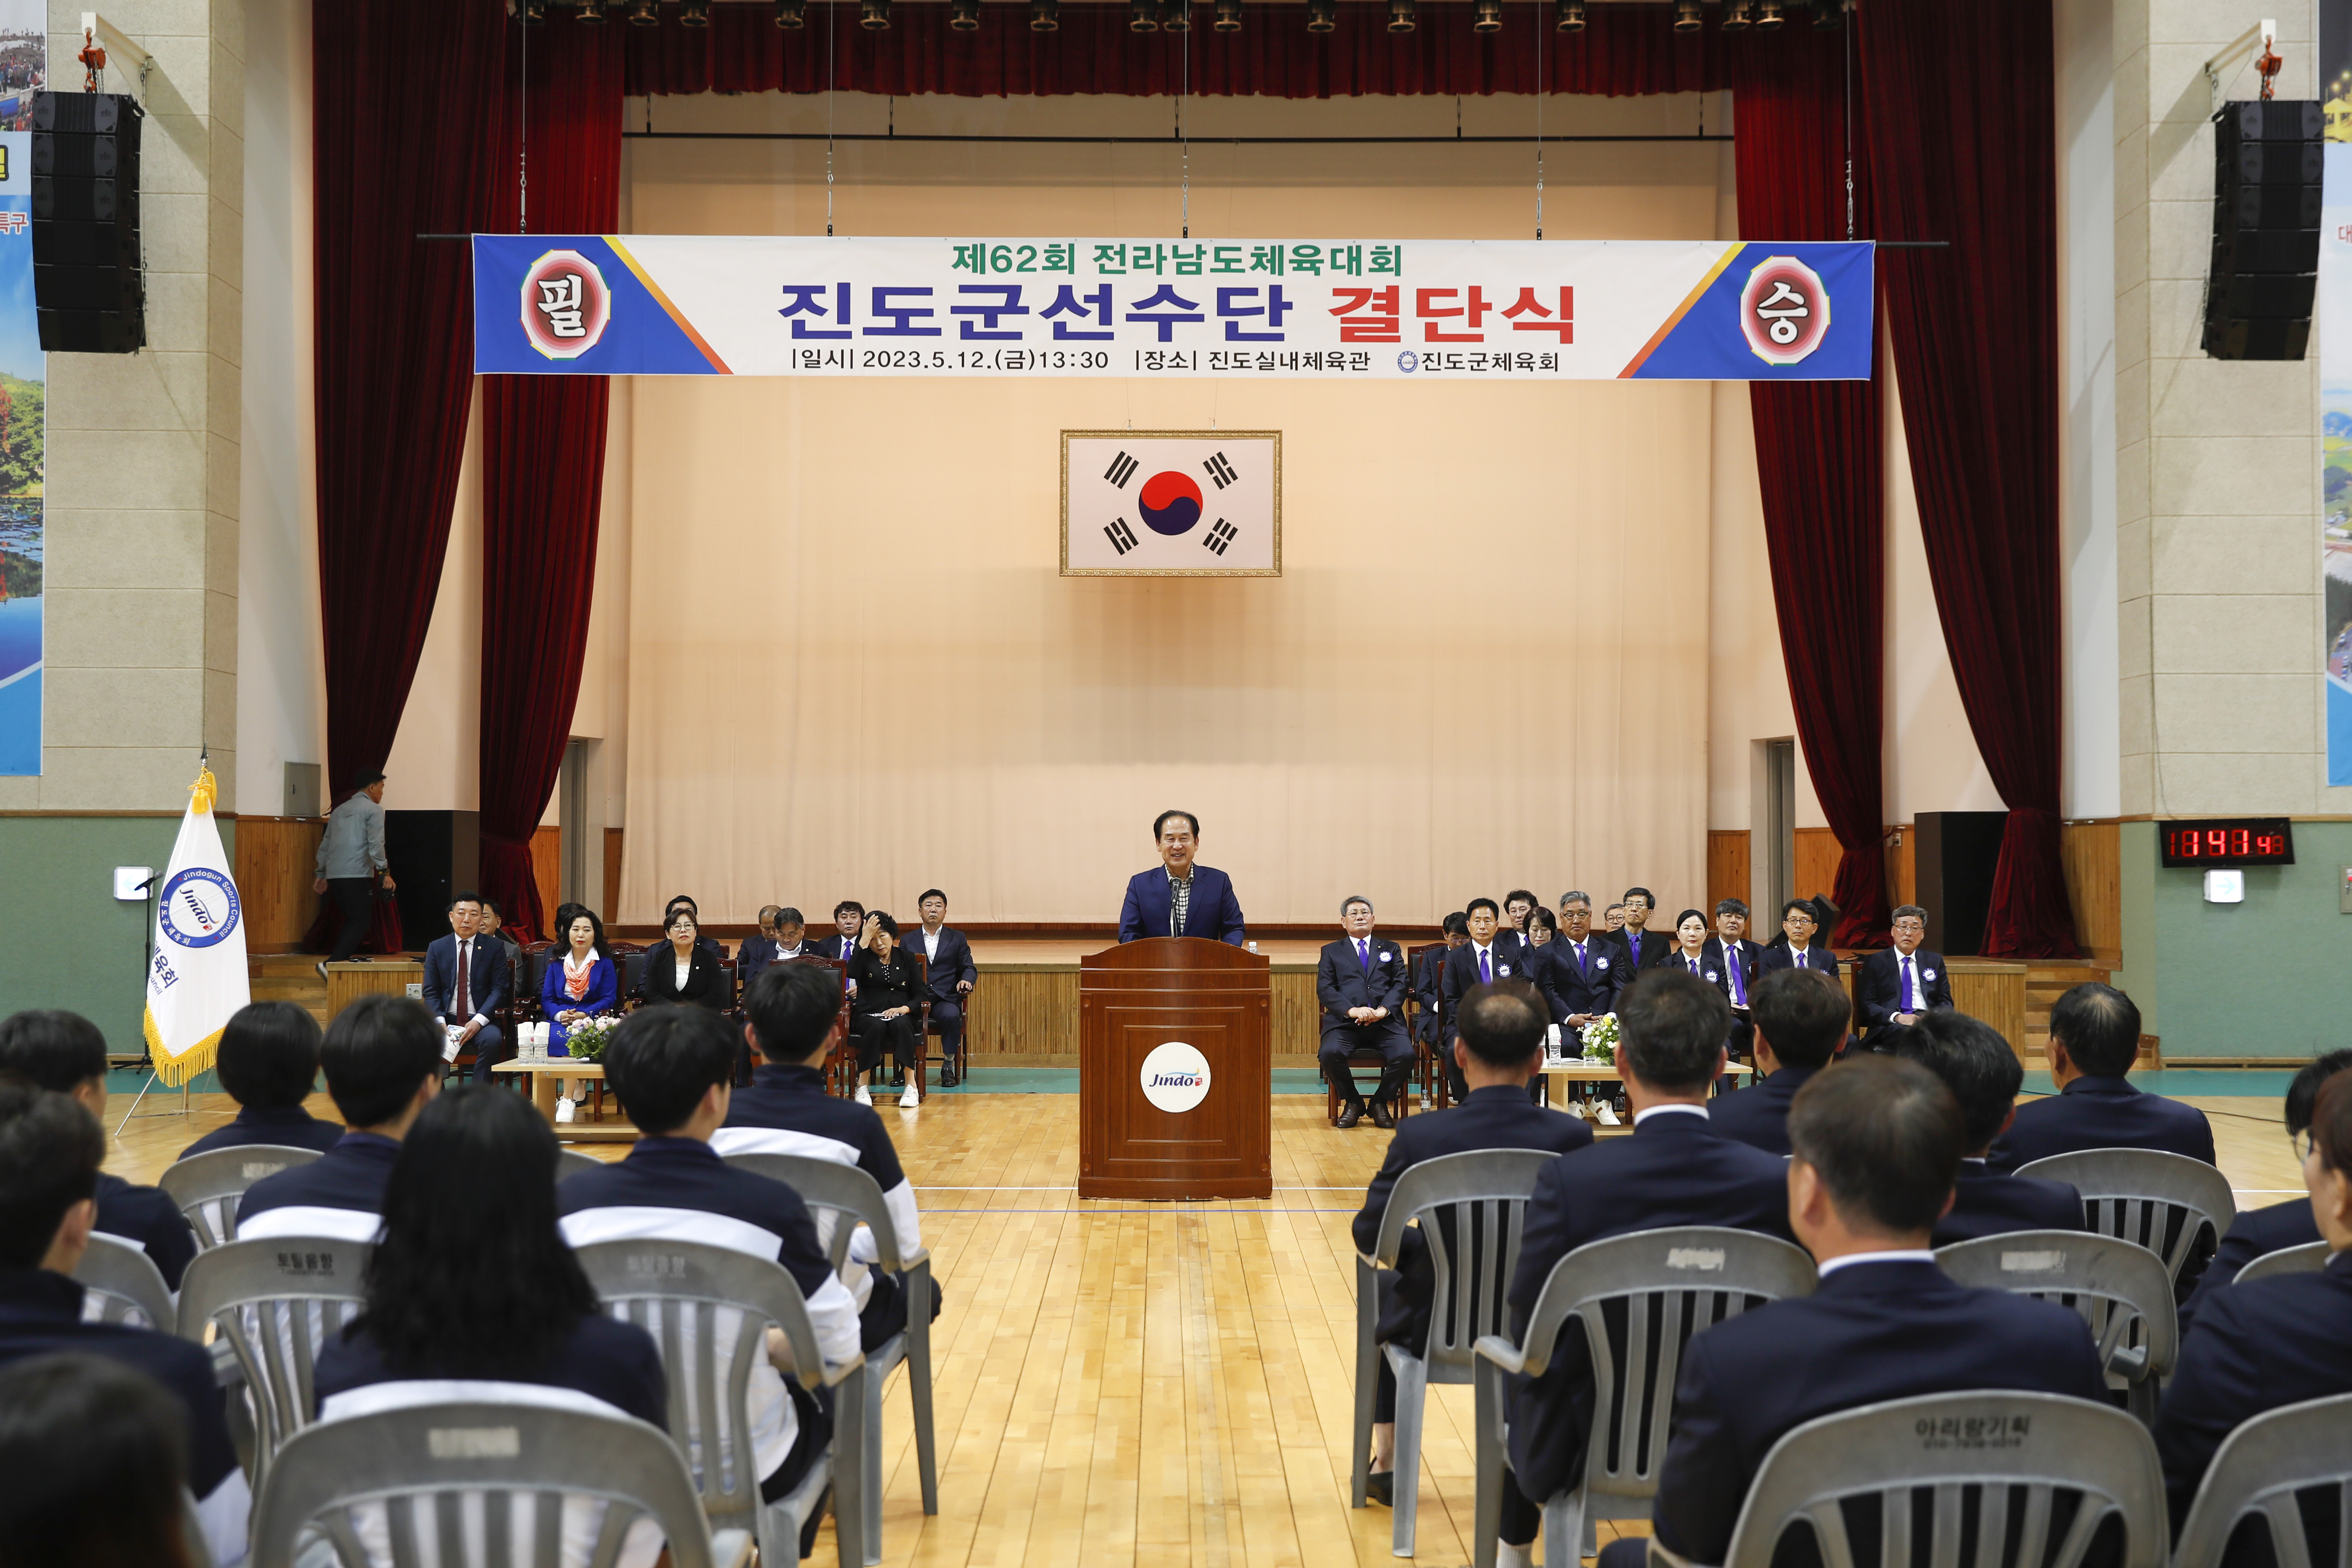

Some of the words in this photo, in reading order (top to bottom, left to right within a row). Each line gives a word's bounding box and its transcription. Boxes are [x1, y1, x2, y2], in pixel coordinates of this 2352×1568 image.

[951, 243, 1075, 275] 제62회
[1092, 243, 1402, 276] 전라남도체육대회
[537, 273, 587, 337] 필
[777, 282, 1293, 343] 진도군선수단
[1328, 285, 1574, 344] 결단식
[1756, 281, 1809, 344] 승
[1208, 350, 1371, 372] 진도실내체육관
[1421, 350, 1559, 373] 진도군체육회
[183, 870, 222, 882] Jindogun
[179, 889, 208, 924] Jindo
[222, 881, 237, 908] Sports
[219, 909, 238, 938] Council
[149, 973, 163, 995] ouncil
[1148, 1074, 1194, 1087] Jindo
